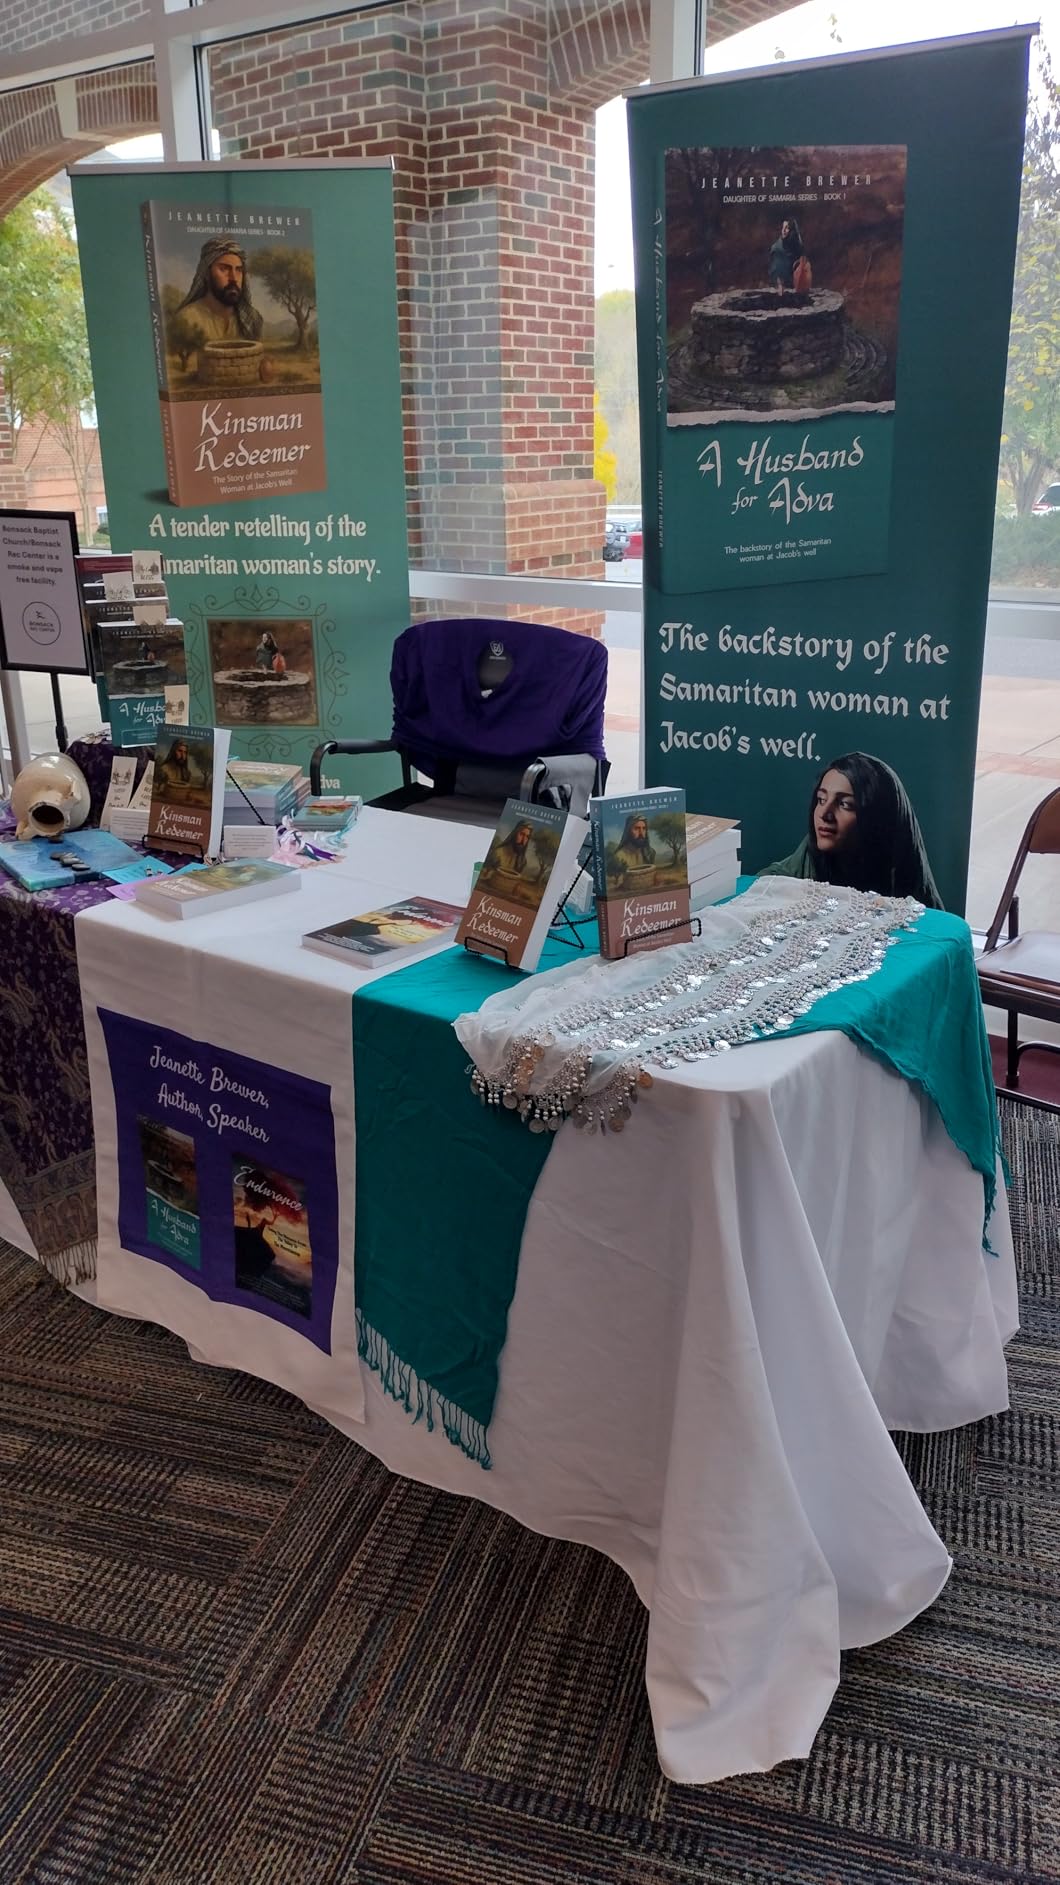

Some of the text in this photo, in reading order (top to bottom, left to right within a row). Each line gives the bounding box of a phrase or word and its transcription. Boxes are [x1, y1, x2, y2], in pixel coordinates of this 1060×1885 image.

[702, 174, 871, 189] JEANETTE BREWER
[723, 195, 756, 203] DAUGHTER
[758, 194, 767, 202] OF
[768, 193, 796, 202] SAMARIA
[797, 193, 818, 201] SERIES
[169, 211, 300, 226] JEANETTE BREWER
[200, 402, 303, 436] Kinsman
[193, 436, 312, 472] Redeemer
[696, 434, 864, 488] A Husband
[213, 476, 226, 484] The
[226, 474, 244, 483] Story
[245, 472, 253, 480] of
[220, 485, 246, 495] Woman
[731, 477, 834, 525] for Adva
[149, 513, 367, 546] A tender retelling of the
[724, 546, 738, 554] The
[740, 544, 772, 553] backstory
[774, 541, 782, 549] of
[798, 538, 832, 547] Samaritan
[739, 554, 764, 562] woman
[776, 549, 801, 559] Jacob's
[803, 548, 817, 556] well
[162, 552, 382, 582] maritan woman's story.
[659, 622, 950, 675] The backstory of the
[659, 672, 951, 721] Samaritan woman at
[660, 720, 821, 762] Jacob's well.
[155, 820, 203, 840] Redeemer
[159, 805, 202, 826] Kinsman
[476, 895, 522, 926] Kinsman
[623, 898, 677, 918] Kinsman
[466, 912, 519, 943] Redeemer
[620, 917, 682, 938] Redeemer
[150, 1045, 269, 1109] Jeanette Brewer,
[158, 1082, 204, 1122] Author,
[206, 1103, 270, 1143] Speaker
[233, 1165, 304, 1211] Endurance
